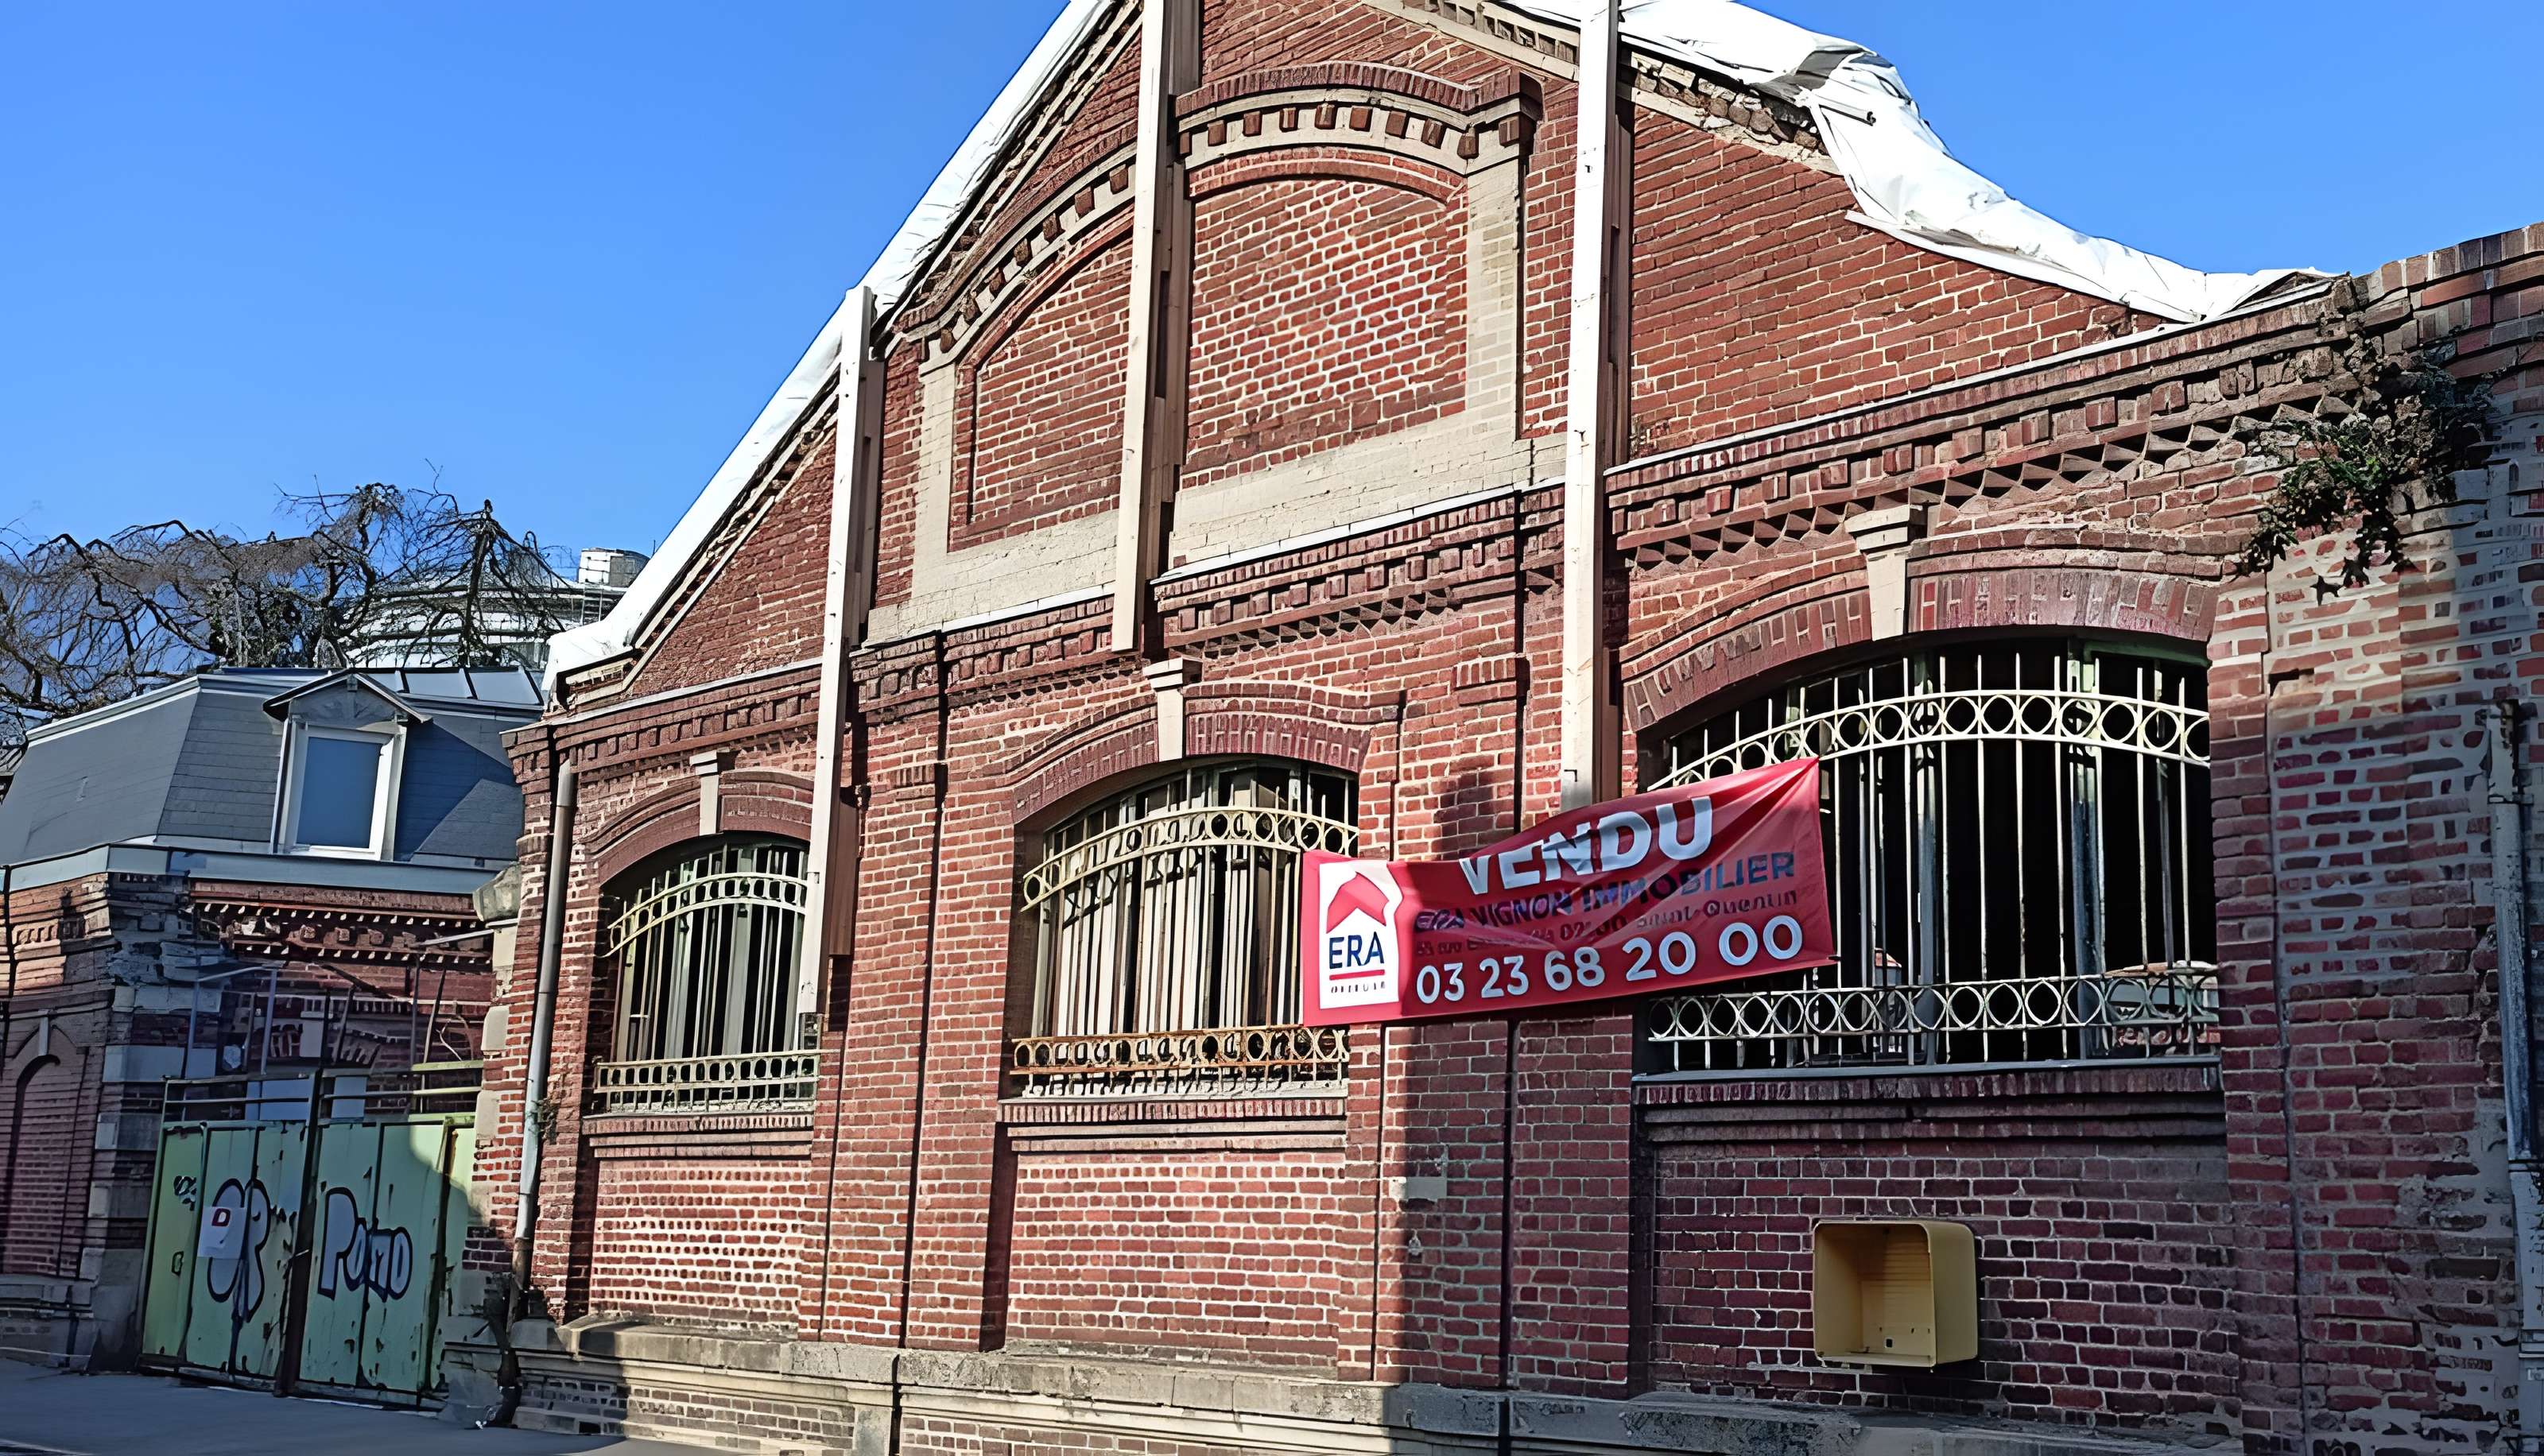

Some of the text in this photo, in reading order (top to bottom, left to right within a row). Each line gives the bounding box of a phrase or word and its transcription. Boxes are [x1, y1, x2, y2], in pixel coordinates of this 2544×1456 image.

[1458, 796, 1713, 895] VENDU
[1328, 931, 1385, 970] ERA
[1416, 915, 1803, 1005] 03 23 68 20 00
